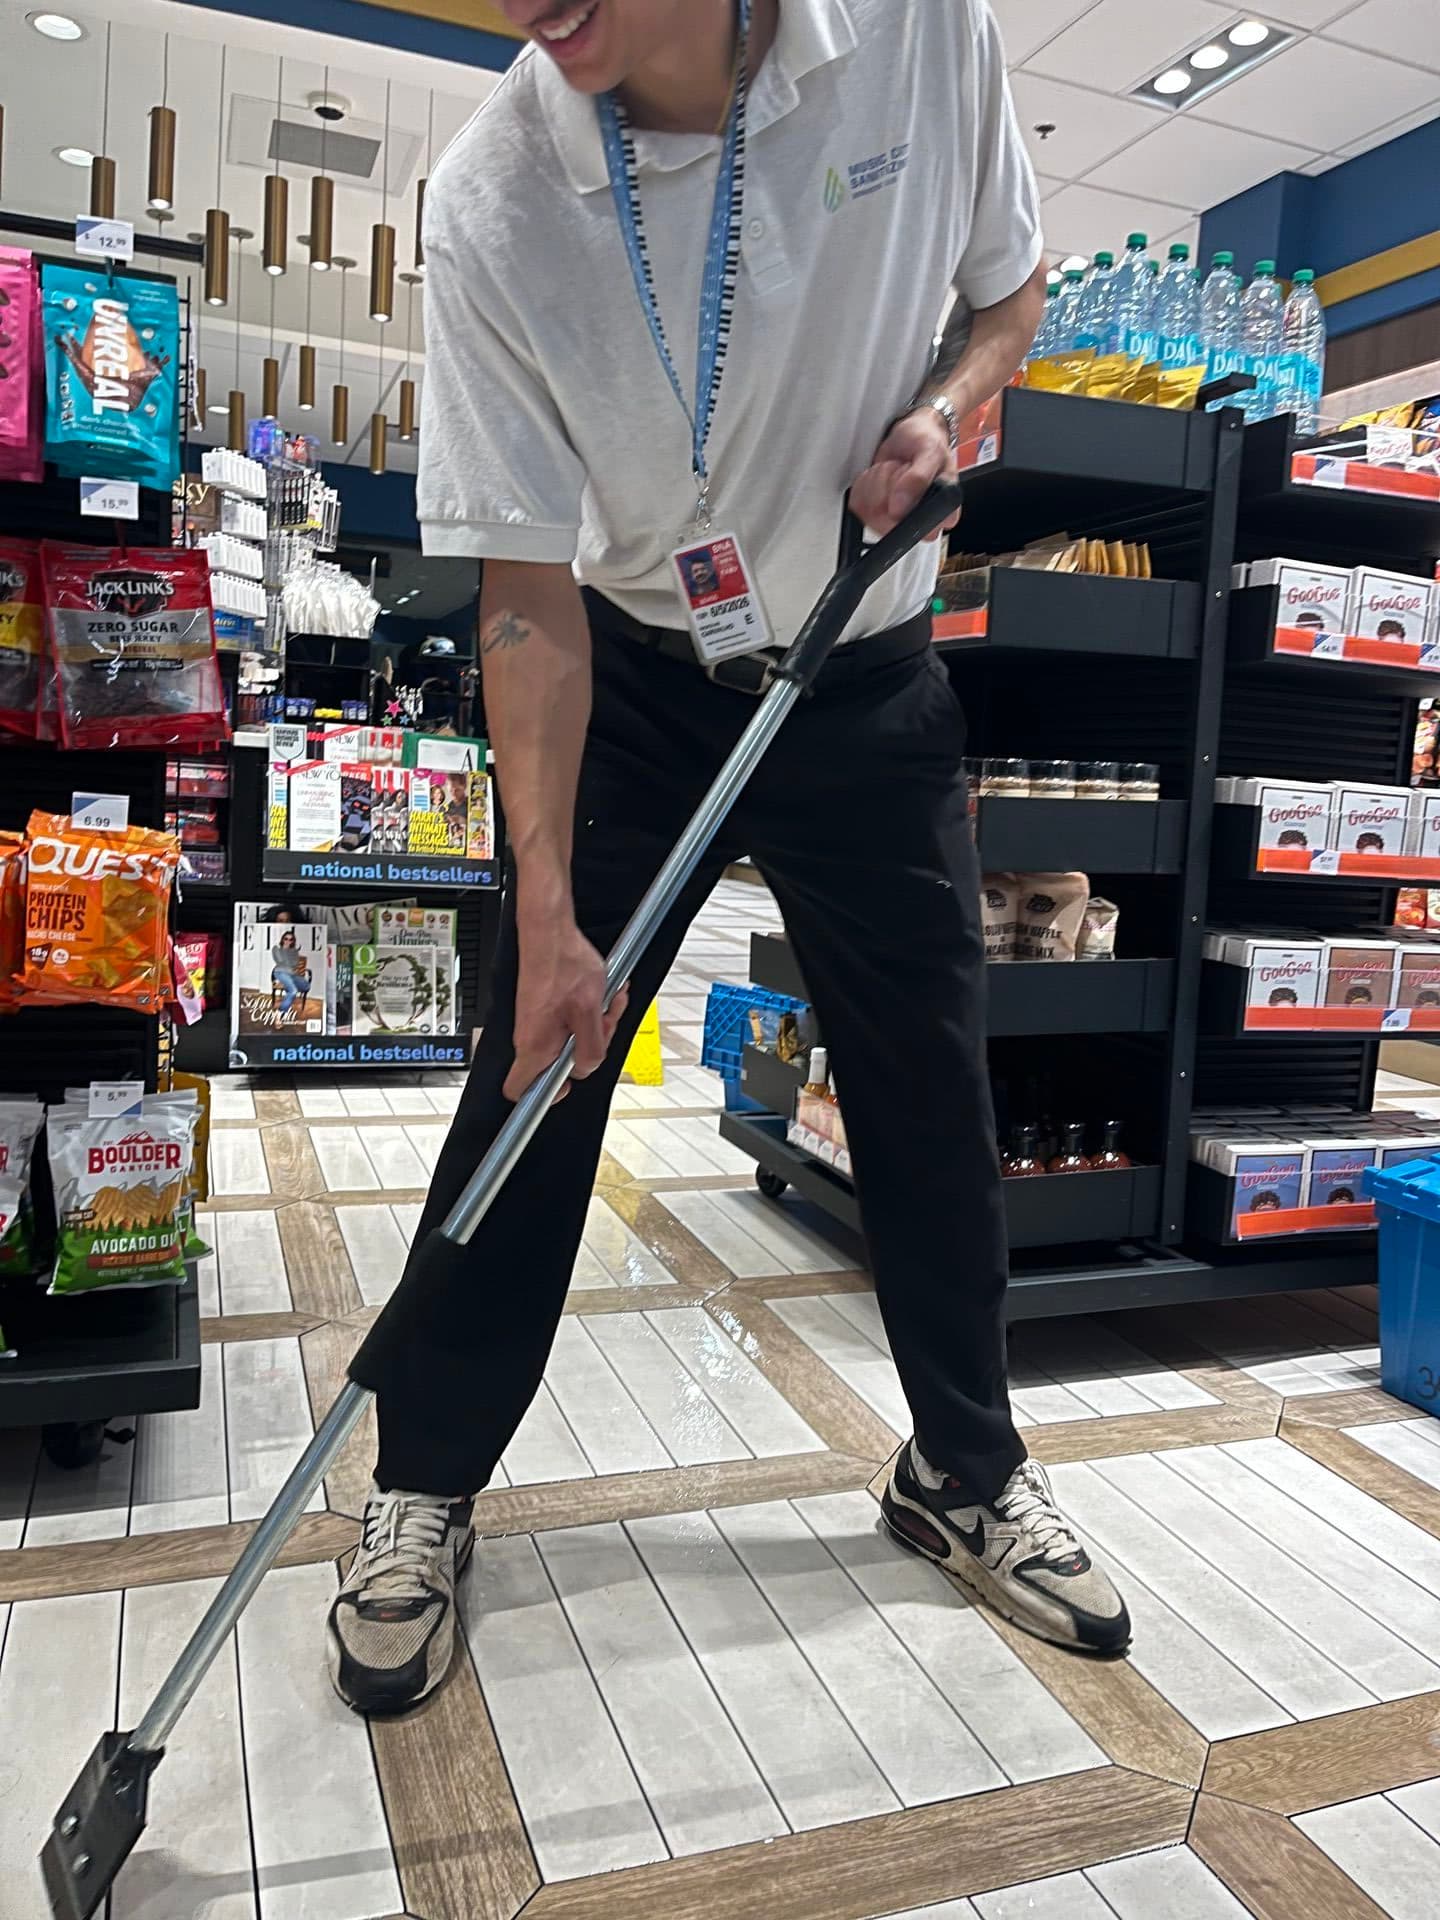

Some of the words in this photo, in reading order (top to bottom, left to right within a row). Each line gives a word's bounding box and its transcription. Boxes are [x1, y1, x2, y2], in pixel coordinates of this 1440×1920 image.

[92, 298, 131, 415] UNREAL
[85, 581, 127, 596] JACK
[87, 622, 126, 633] ZERO
[131, 622, 179, 633] SUGAR
[84, 816, 111, 828] 6.99
[301, 861, 382, 879] national
[388, 864, 492, 884] bestsellers
[29, 892, 87, 910] PROTEIN
[27, 909, 85, 931] CHIPS
[273, 1044, 354, 1061] national
[360, 1044, 464, 1061] bestsellers
[87, 1143, 181, 1174] BOULDER
[110, 1164, 160, 1173] CANYON
[91, 1236, 155, 1254] AVOCADO
